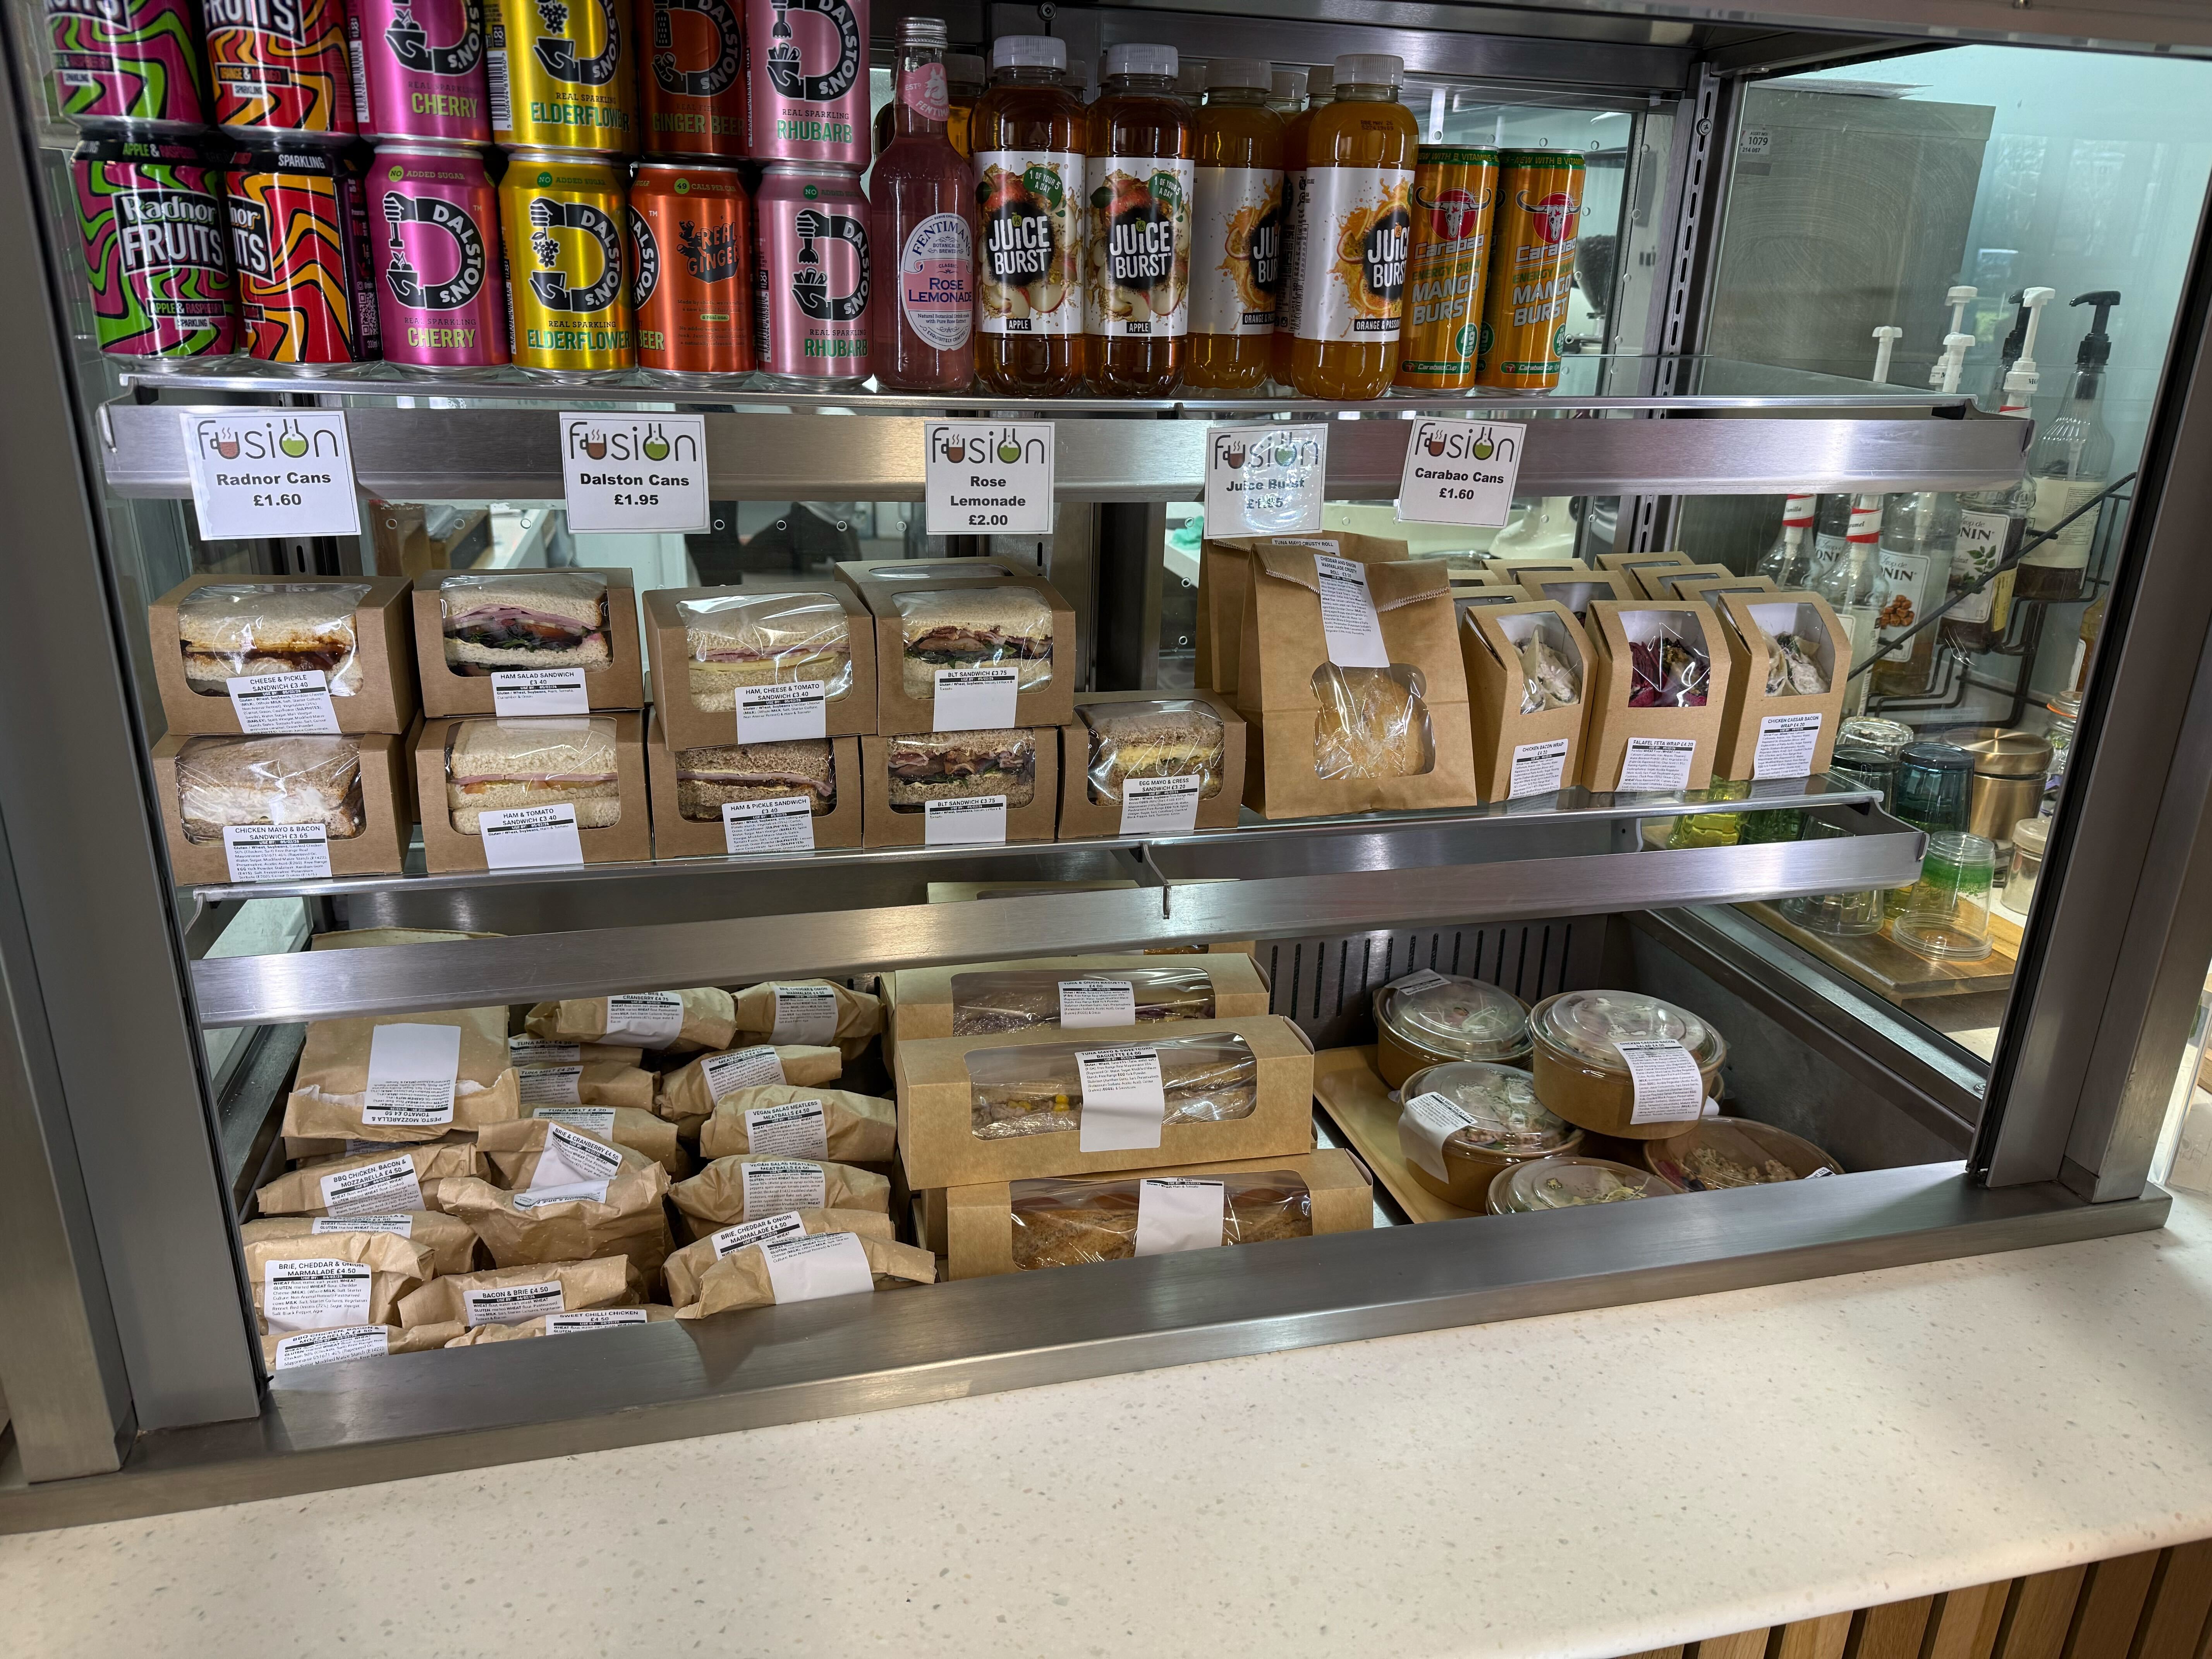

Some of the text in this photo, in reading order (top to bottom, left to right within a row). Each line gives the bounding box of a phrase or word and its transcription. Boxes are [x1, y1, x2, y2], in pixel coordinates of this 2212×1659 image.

[805, 110, 848, 120] SPARKLING
[778, 118, 852, 143] RHUBARB
[1749, 137, 1768, 145] 1079
[278, 155, 325, 169] SPARKLING
[407, 171, 435, 179] ADDED
[438, 171, 465, 180] SUGAR
[1035, 172, 1041, 181] OF
[1042, 174, 1055, 185] YOUR
[1055, 181, 1061, 189] 5
[692, 183, 709, 191] CALS
[1041, 184, 1050, 193] DAY
[121, 196, 216, 222] Radnor
[912, 220, 971, 255] FENTIMANS
[124, 225, 223, 266] FRUITS
[433, 204, 482, 304] DALSTON'S
[995, 249, 1047, 274] BURST
[1412, 272, 1479, 302] MANGO
[909, 289, 972, 302] LEMONADE
[151, 302, 175, 313] APPLE
[176, 302, 184, 313] &
[1413, 298, 1473, 326] BURST
[176, 318, 208, 327] SPARKLING
[1009, 320, 1028, 329] APPLE
[1357, 321, 1385, 330] ORANGE &
[408, 327, 475, 349] CHERRY
[527, 330, 630, 350] ELDERFLOWER
[217, 472, 331, 485] Radnor Cans
[581, 474, 689, 486] Dalston Cans
[970, 476, 1006, 486] Rose
[1415, 467, 1504, 484] Carabao Cans
[1226, 479, 1263, 491] Juice
[254, 494, 301, 506] £1.60
[615, 495, 658, 505] £1.95
[951, 496, 1025, 506] Lemonade
[1439, 489, 1474, 500] £1.60
[969, 515, 1008, 525] £2.00
[555, 1128, 567, 1137] BRIE
[573, 1136, 605, 1153] CRANBERRY
[605, 1150, 618, 1160] £4.50
[349, 1167, 377, 1179] CHICKEN,
[378, 1161, 400, 1170] BACON
[341, 1171, 383, 1187] MOZZARELLA
